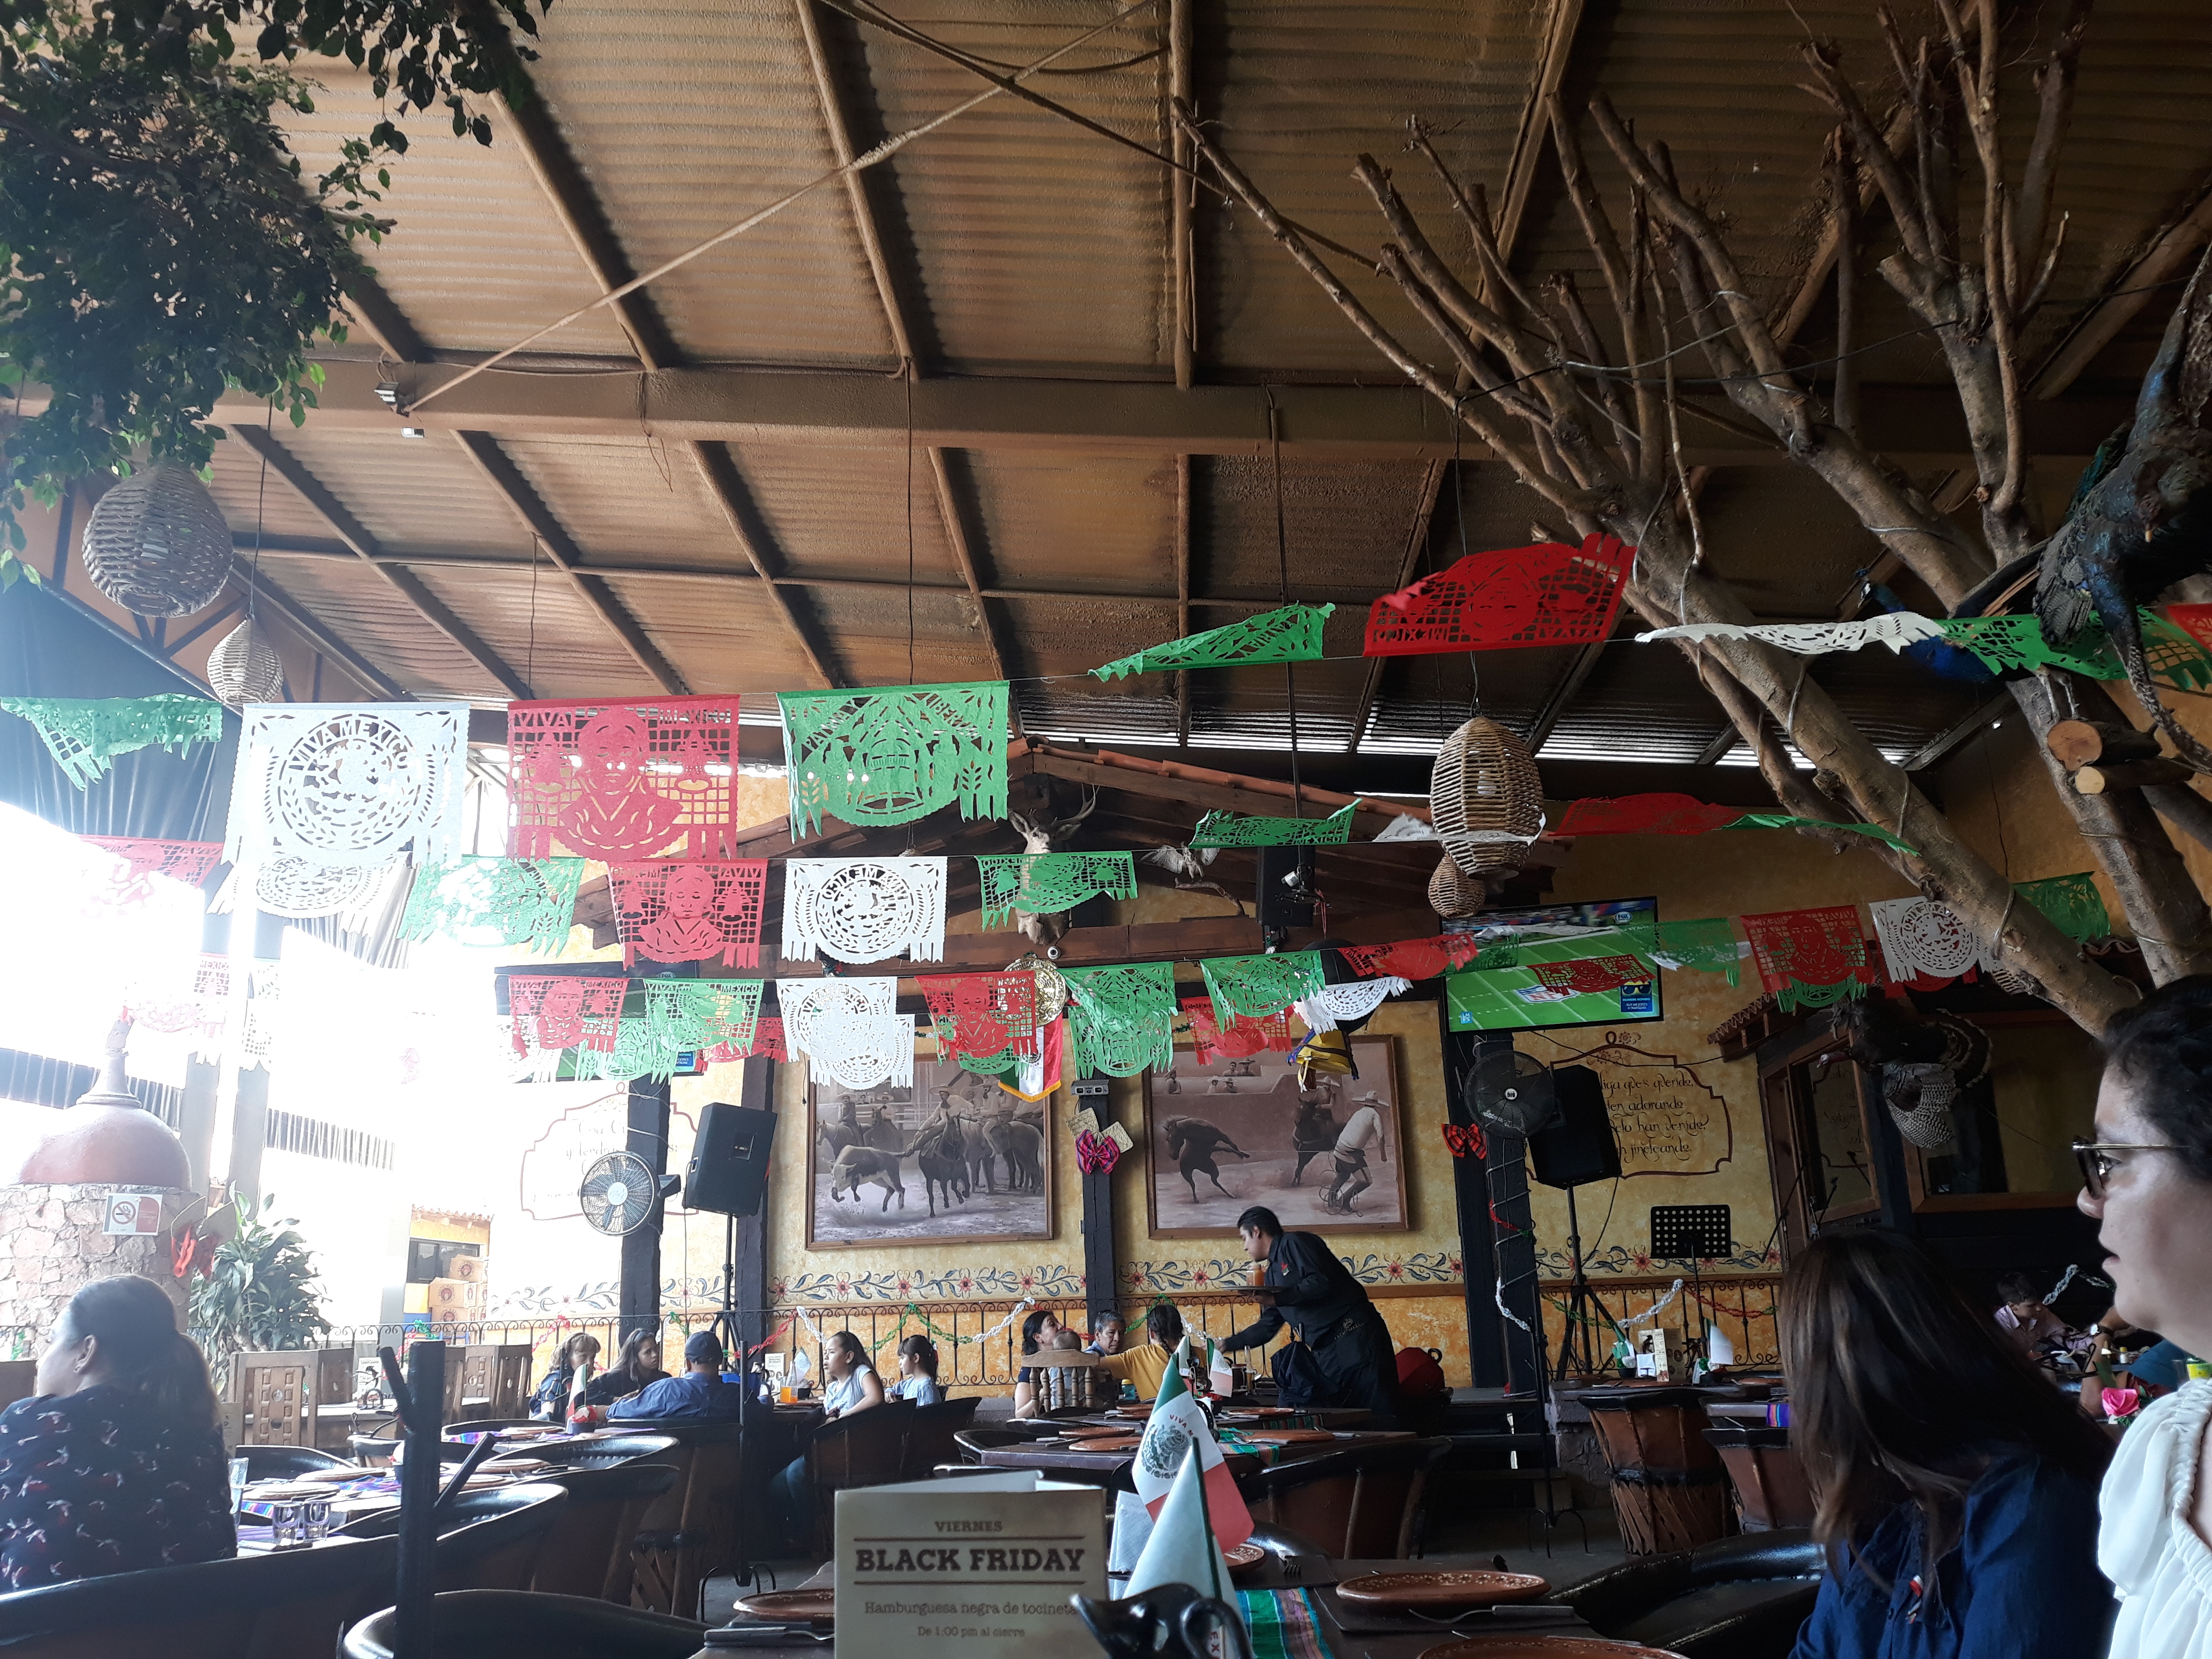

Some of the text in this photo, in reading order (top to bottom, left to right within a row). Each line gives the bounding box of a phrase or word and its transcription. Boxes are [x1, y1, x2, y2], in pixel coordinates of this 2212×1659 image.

[514, 712, 573, 727] VIVA
[287, 718, 410, 771] VIVA MEXICO
[646, 983, 760, 993] VIVA MEXICO
[1169, 1414, 1188, 1429] VIVA
[934, 1520, 1004, 1533] VIERNES
[856, 1548, 1086, 1572] BLACK FRIDAY
[865, 1602, 958, 1616] Hamburguesa
[961, 1604, 1001, 1616] negra
[1003, 1602, 1020, 1615] de
[917, 1626, 1025, 1638] De 1:00 pm al cierre
